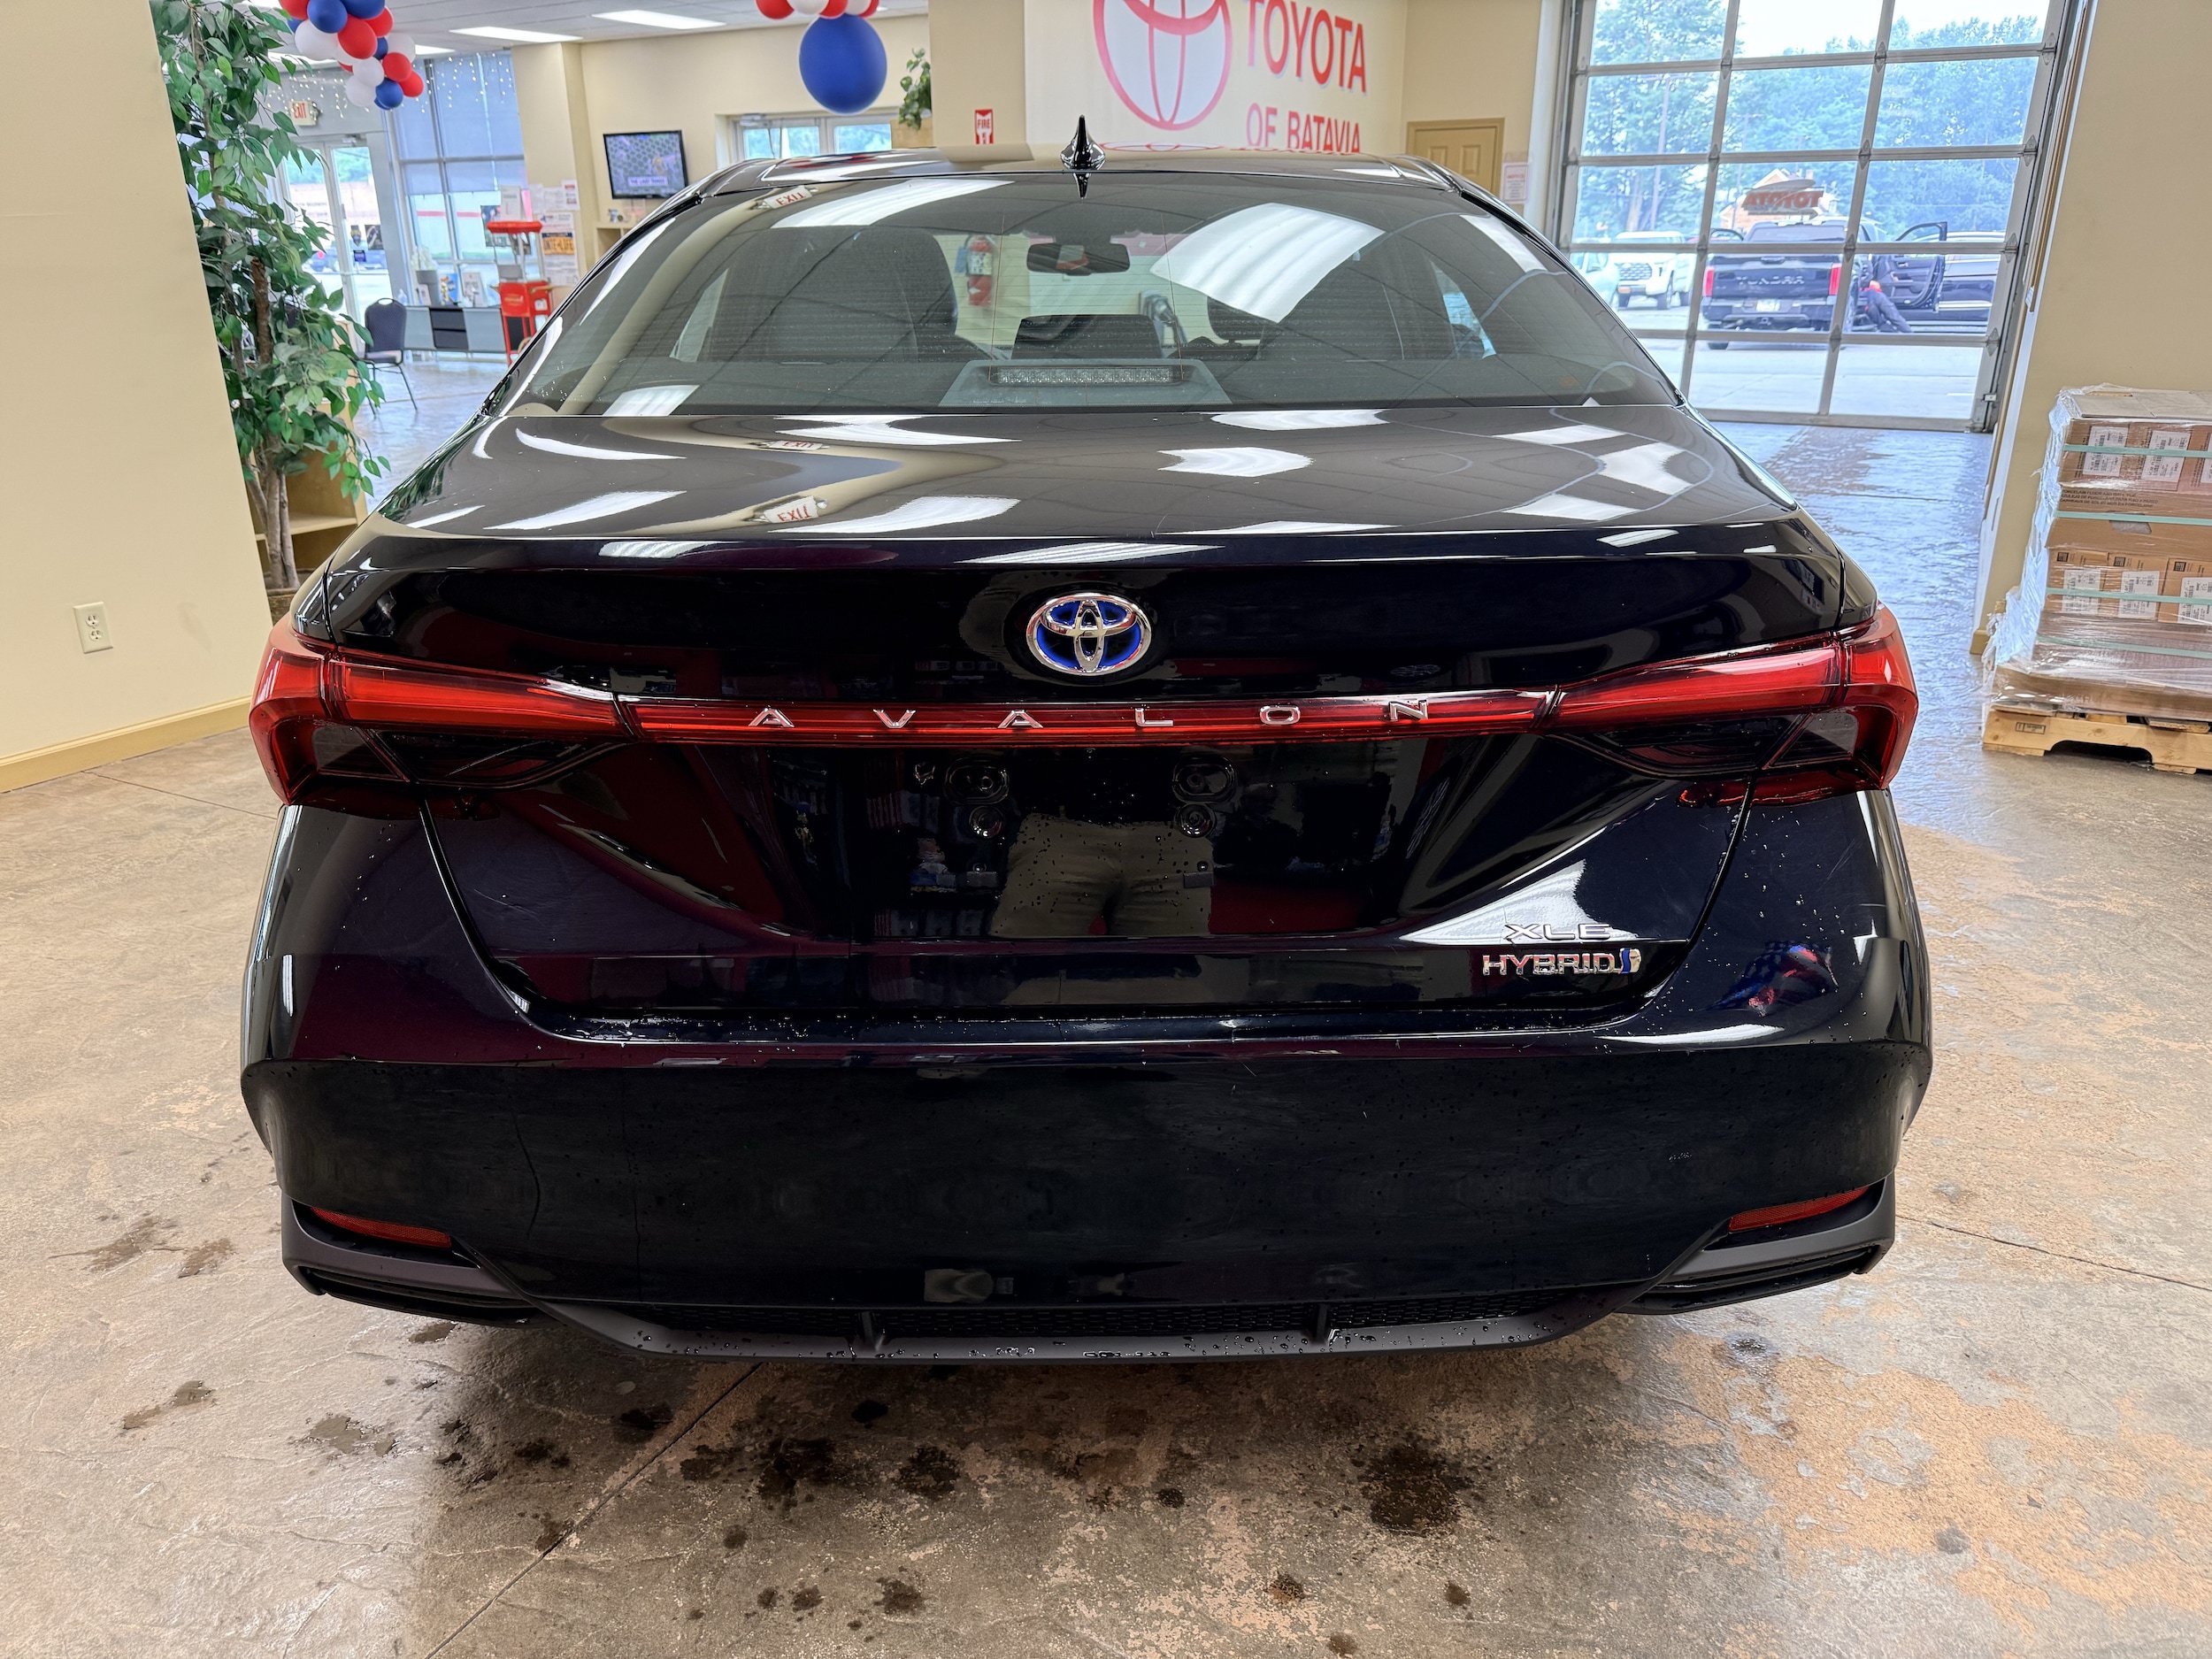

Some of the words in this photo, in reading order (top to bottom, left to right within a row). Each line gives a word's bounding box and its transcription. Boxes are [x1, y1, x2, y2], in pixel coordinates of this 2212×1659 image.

[1246, 0, 1366, 93] TOYOTA
[292, 103, 307, 119] EXIT
[978, 119, 990, 129] FIRE
[1247, 103, 1278, 148] OF
[1287, 111, 1360, 153] BATAVIA
[1736, 275, 1805, 286] TUNDRA
[748, 700, 1429, 729] AVALON
[1504, 923, 1611, 941] XLE
[1482, 953, 1616, 976] HYBRID
